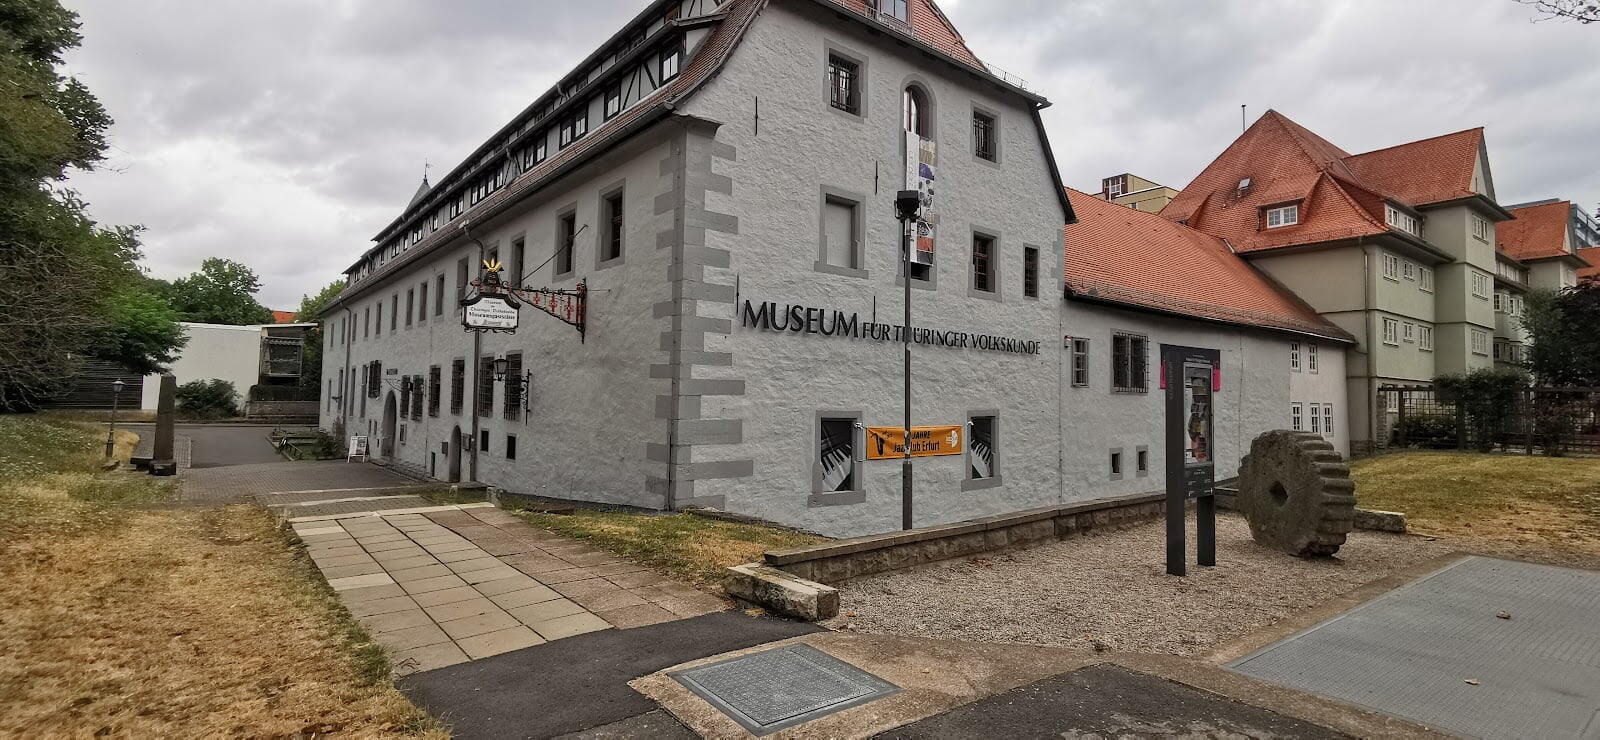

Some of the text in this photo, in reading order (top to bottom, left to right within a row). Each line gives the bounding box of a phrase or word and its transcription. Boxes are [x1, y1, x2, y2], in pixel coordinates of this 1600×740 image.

[743, 300, 859, 337] MUSEUM
[862, 322, 891, 341] FÜR
[971, 333, 1041, 355] VOLKSKUNDE
[912, 431, 930, 439] JAHRE
[922, 440, 940, 452] Erfurt
